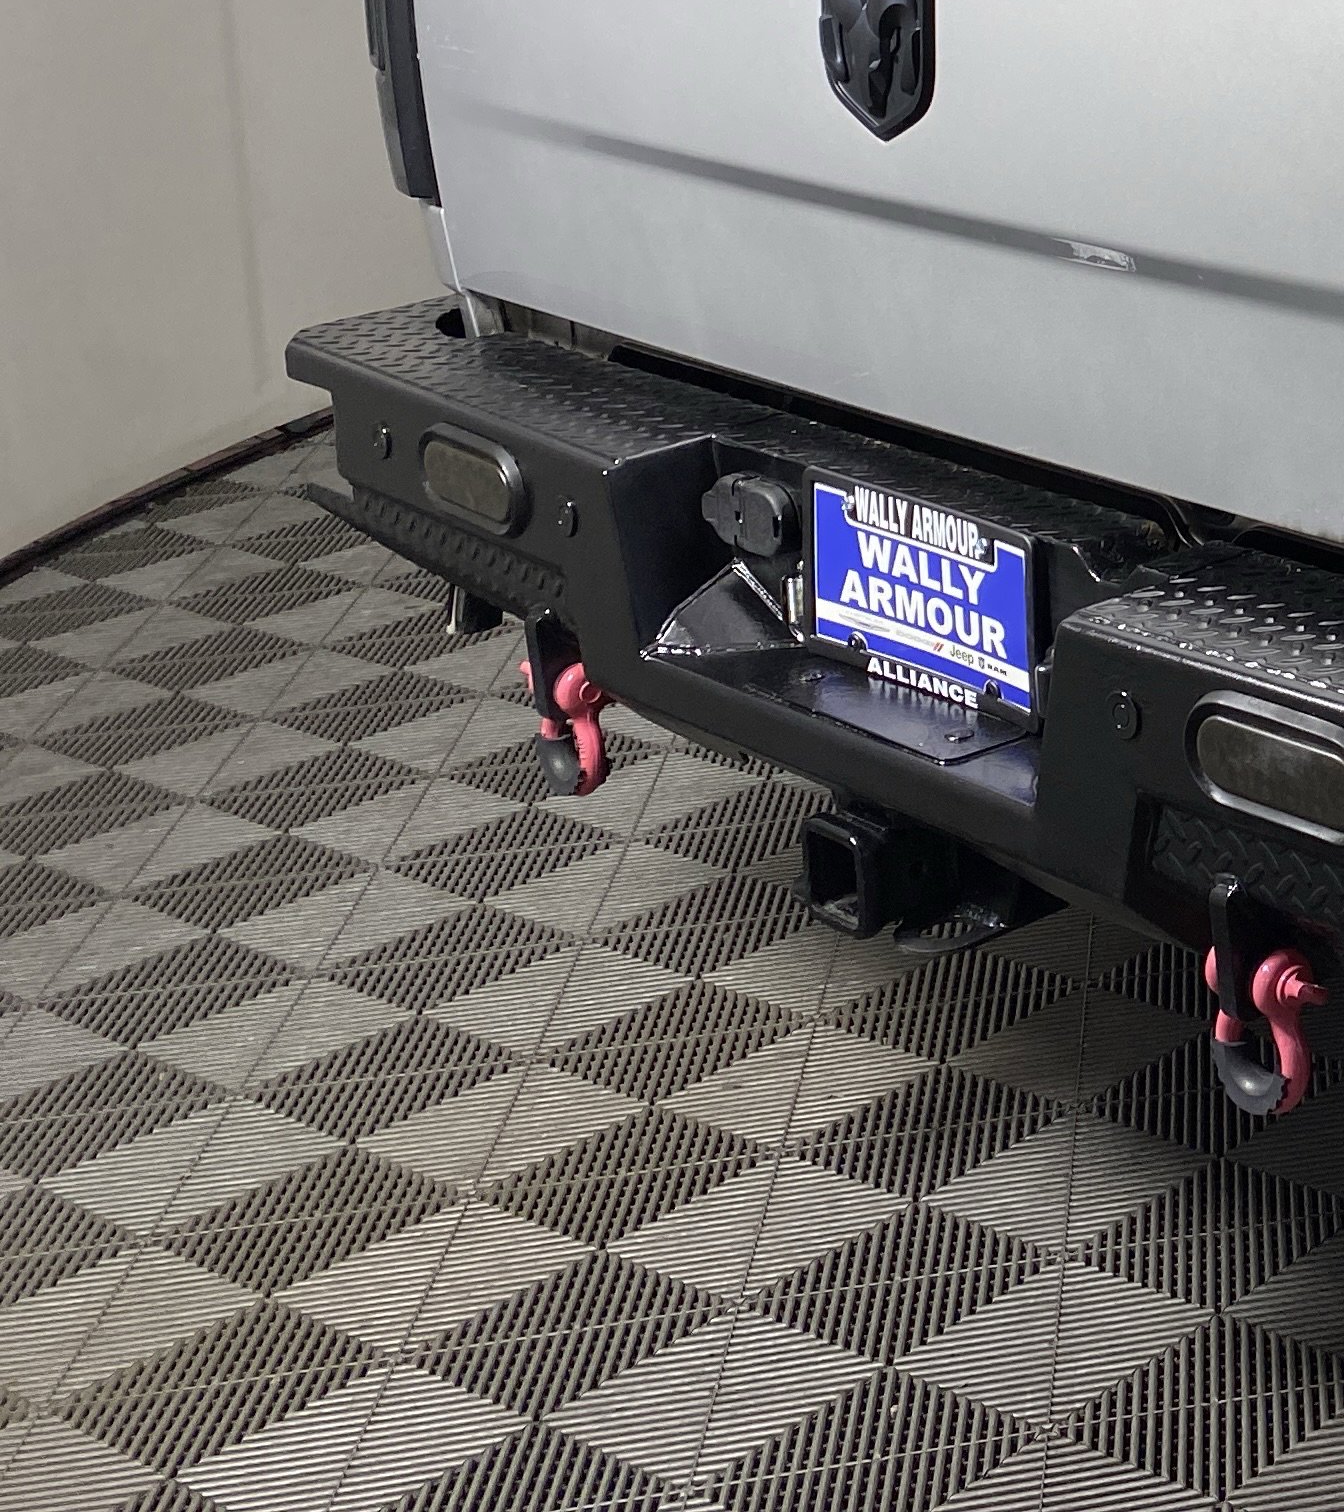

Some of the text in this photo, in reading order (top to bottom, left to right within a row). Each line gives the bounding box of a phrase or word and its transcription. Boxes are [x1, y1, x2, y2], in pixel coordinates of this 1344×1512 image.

[854, 485, 908, 535] WALLY
[857, 531, 985, 605] WALLY
[840, 569, 1007, 659] ARMOUR
[949, 644, 975, 666] Jeep
[987, 664, 1008, 677] RAM
[867, 657, 979, 709] ALLIANCE
